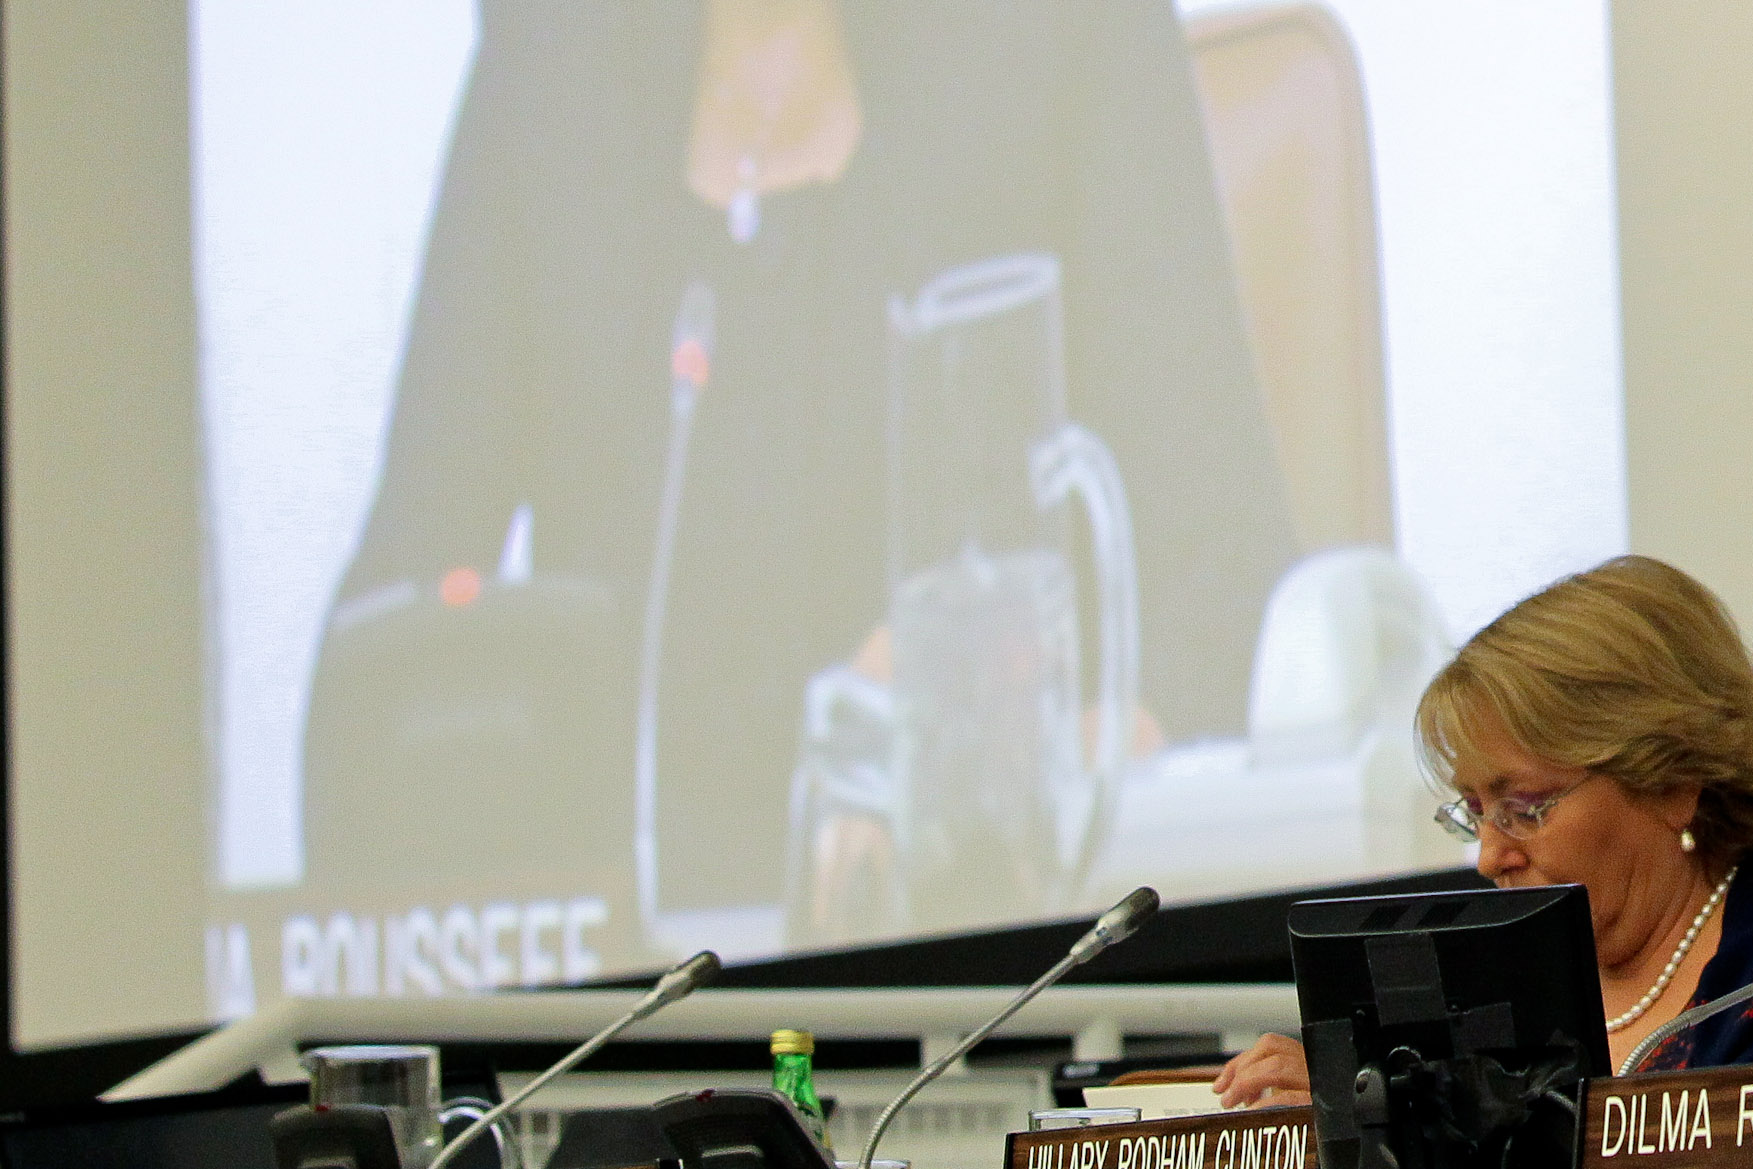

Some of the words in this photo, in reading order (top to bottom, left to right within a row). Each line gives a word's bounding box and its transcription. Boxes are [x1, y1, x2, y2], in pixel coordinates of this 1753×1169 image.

[1117, 1131, 1206, 1169] RODHAM
[1214, 1123, 1309, 1169] CLINTON
[1601, 1087, 1713, 1158] DILMA
